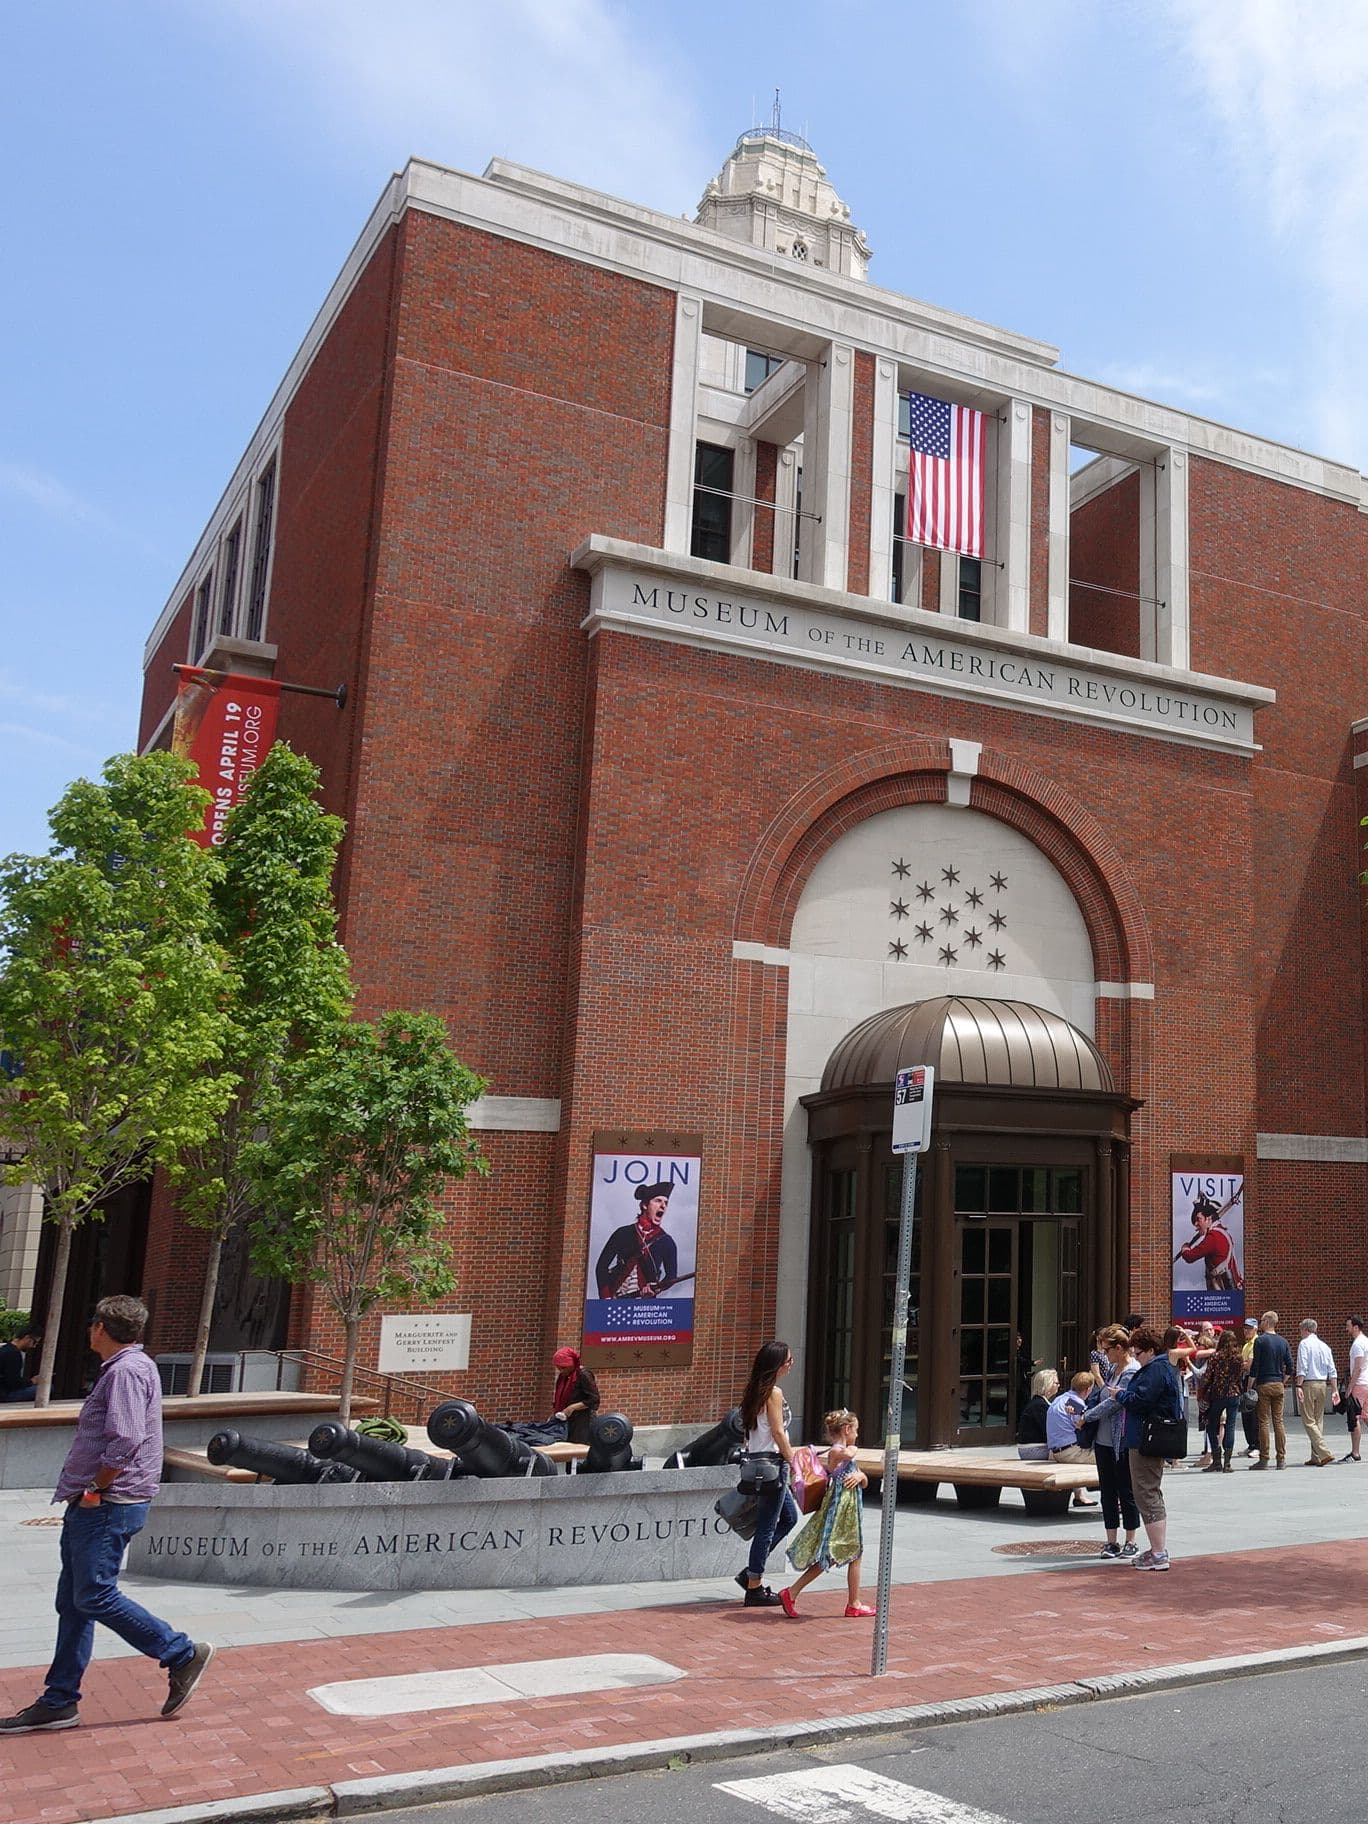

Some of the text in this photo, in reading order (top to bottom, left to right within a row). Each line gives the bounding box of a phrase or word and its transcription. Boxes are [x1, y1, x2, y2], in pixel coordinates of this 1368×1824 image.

[631, 583, 1238, 730] MUSEUM OF THE AMERICAN REVOLUTION
[211, 702, 242, 845] OPENS APRIL 19
[897, 1089, 906, 1104] 57
[603, 1160, 689, 1185] JOIN
[1180, 1177, 1236, 1198] VISIT
[148, 1517, 731, 1556] MUSEUM OF THE AMERICAN REVOLUTIO
